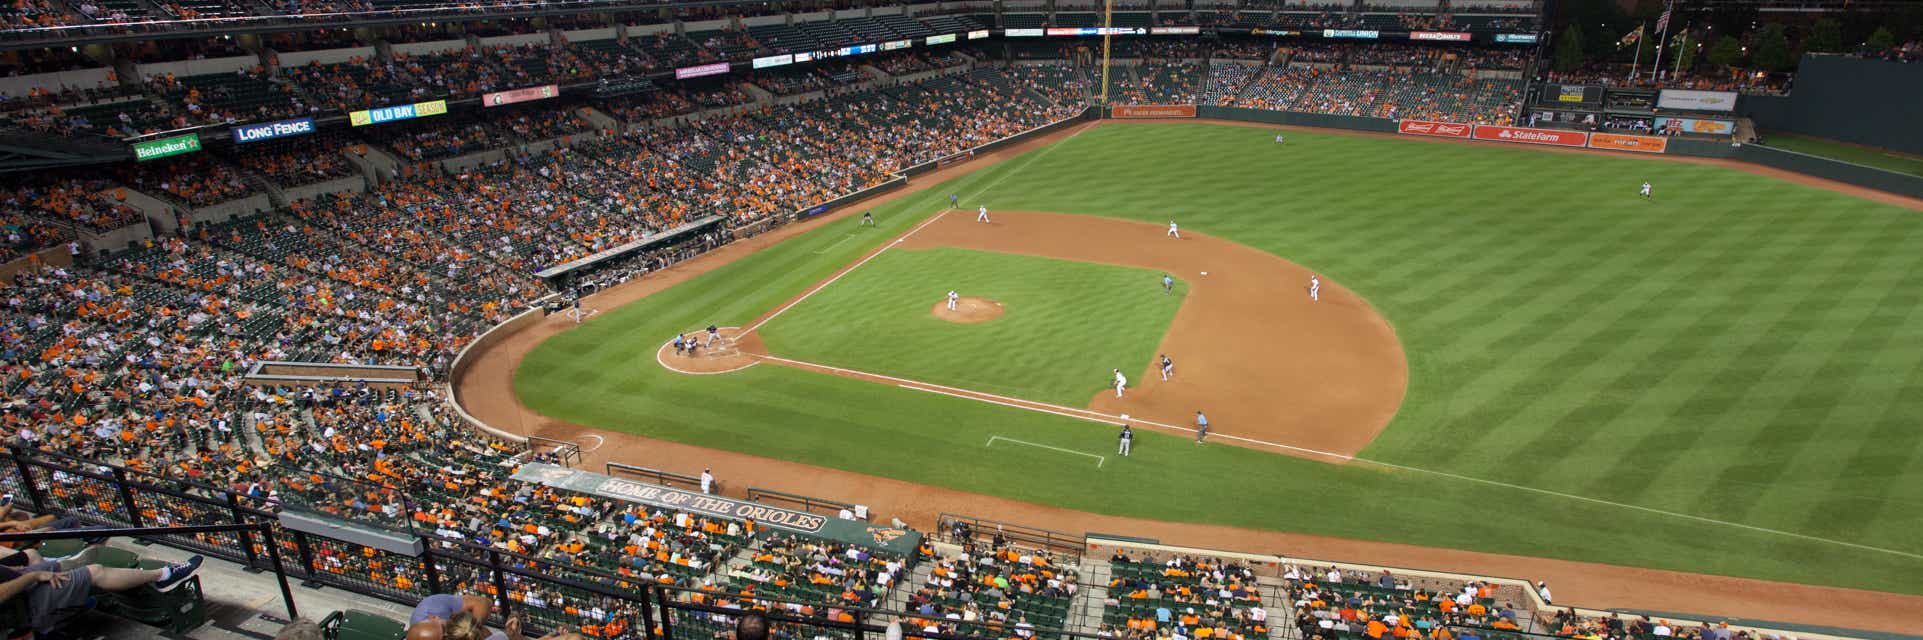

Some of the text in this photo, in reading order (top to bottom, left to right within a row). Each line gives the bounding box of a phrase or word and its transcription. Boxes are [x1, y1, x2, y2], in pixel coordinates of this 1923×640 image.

[373, 109, 393, 122] OLD
[394, 105, 414, 119] BAY
[417, 102, 444, 114] SEASON
[238, 121, 310, 142] LONG FENCE
[136, 140, 188, 159] Heineken
[603, 480, 821, 529] HOME OF THE ORIOLES
